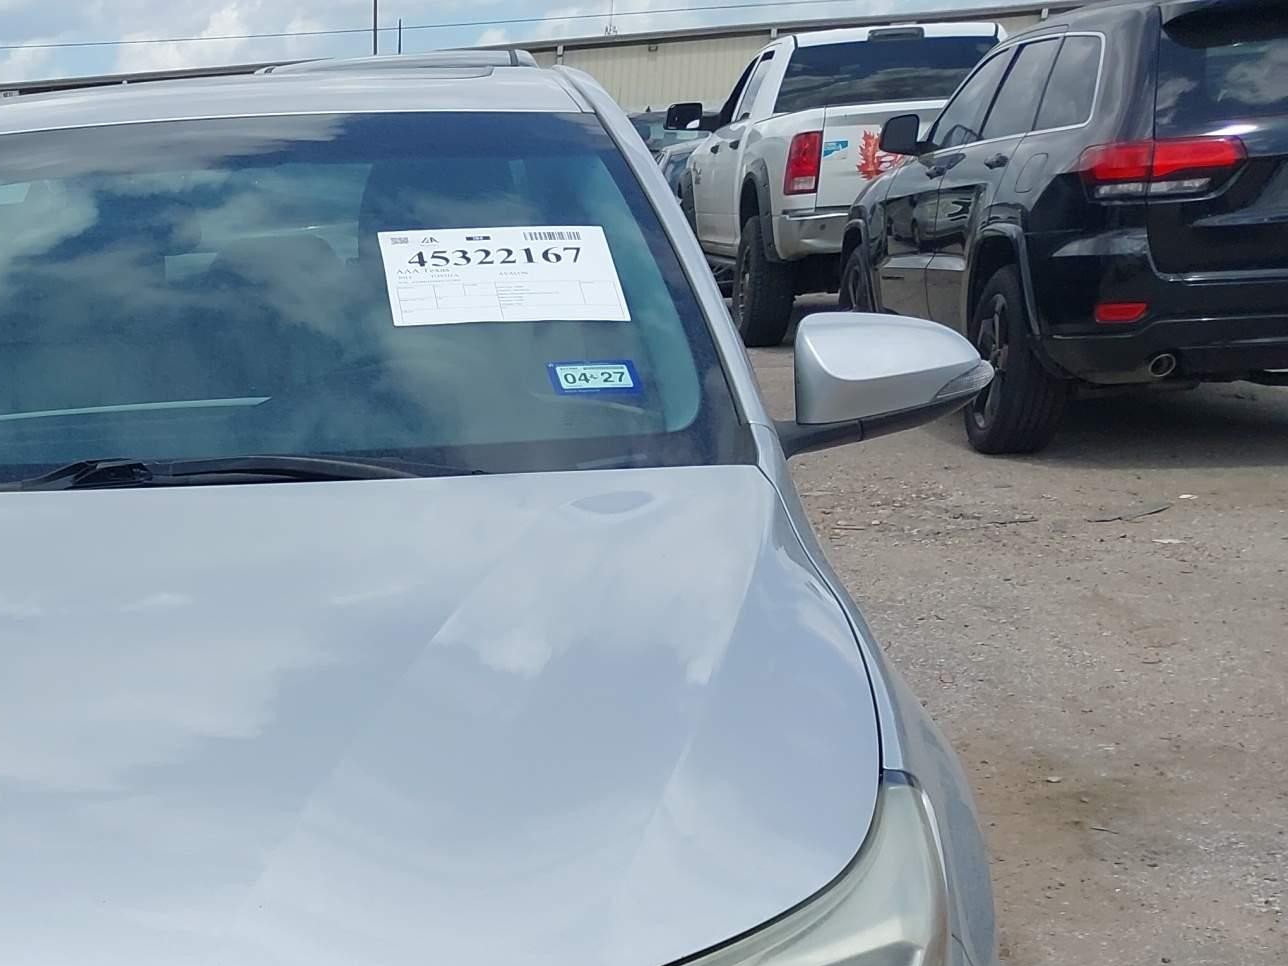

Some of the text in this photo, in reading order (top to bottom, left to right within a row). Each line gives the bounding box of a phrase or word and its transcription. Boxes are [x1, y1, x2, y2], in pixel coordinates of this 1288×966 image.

[407, 246, 582, 268] 45322167
[563, 371, 625, 385] 04 27
